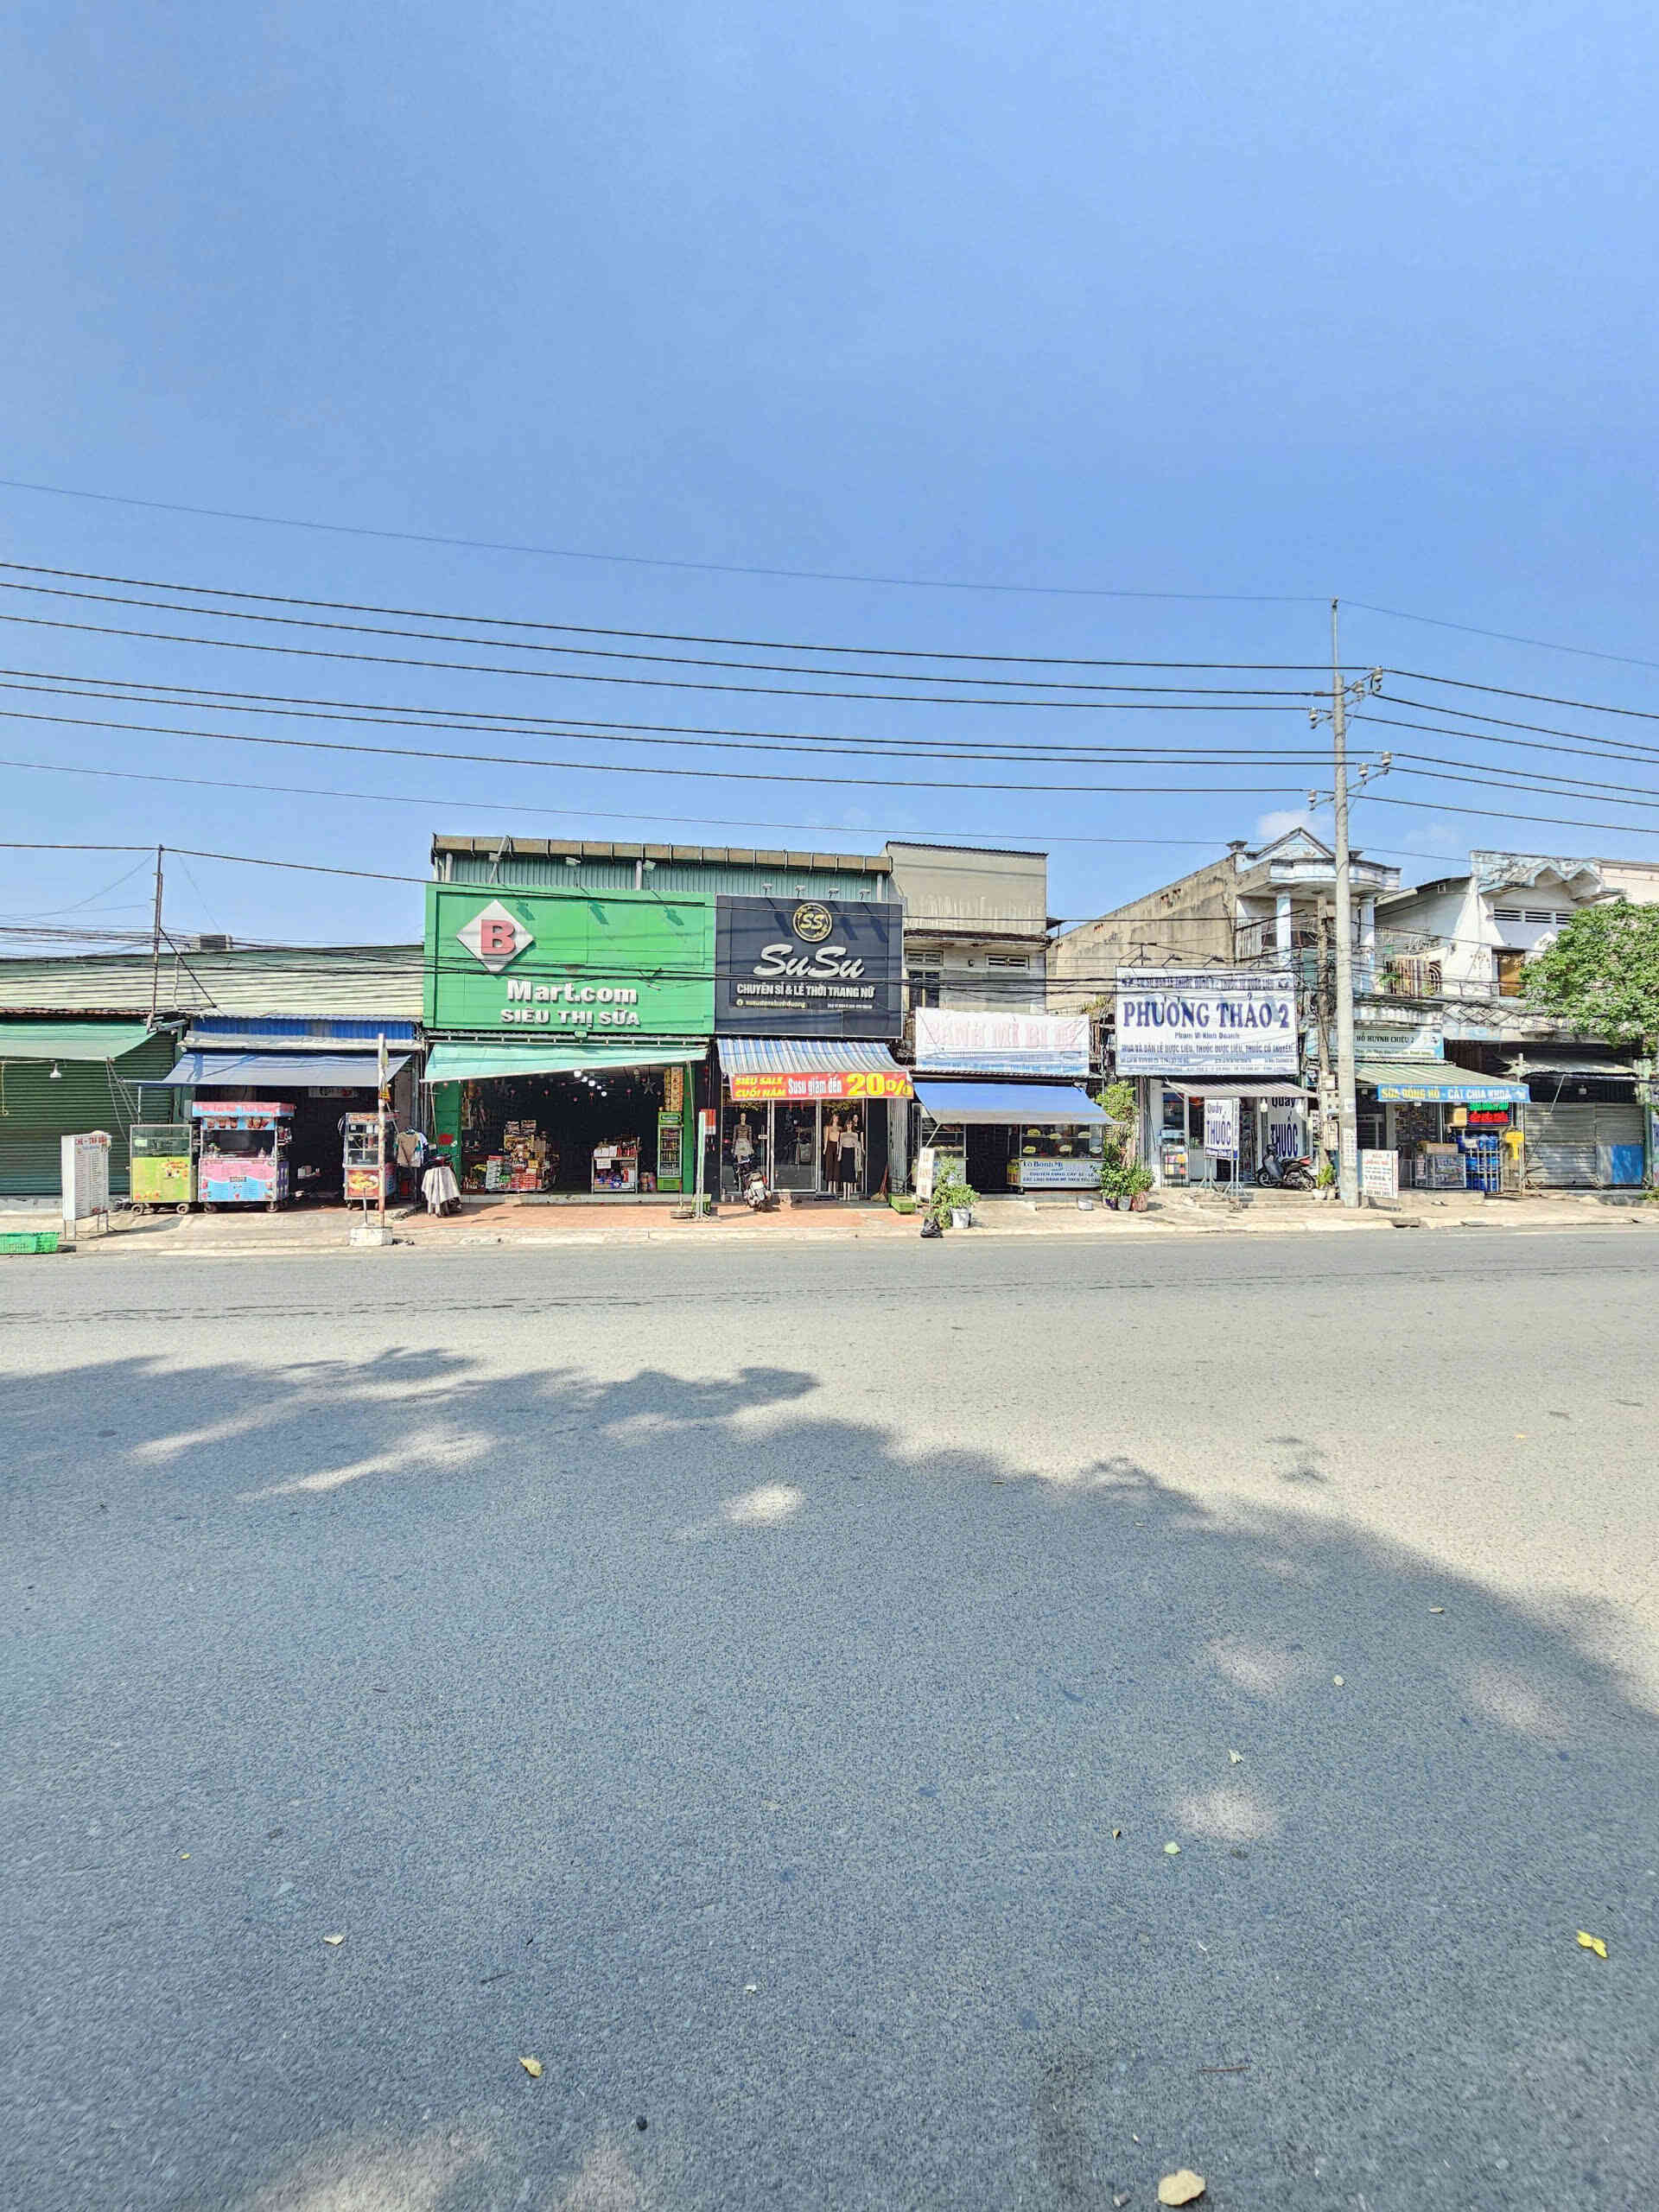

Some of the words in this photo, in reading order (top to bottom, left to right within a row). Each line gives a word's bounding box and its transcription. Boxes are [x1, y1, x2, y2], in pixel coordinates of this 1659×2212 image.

[480, 919, 516, 956] B
[507, 980, 638, 1005] Mart.com
[736, 982, 773, 995] CHUYÊN
[785, 984, 793, 995] &
[806, 983, 827, 997] THỜI
[827, 986, 859, 998] TRANG
[860, 986, 875, 999] NỮ
[500, 1008, 550, 1024] SIÊU
[558, 1010, 594, 1029] THỊ
[599, 1009, 640, 1027] SỮA
[1123, 995, 1210, 1027] PHƯƠNG
[1217, 993, 1273, 1028] THẢO
[1278, 1002, 1289, 1028] 2
[846, 1072, 912, 1096] 20%
